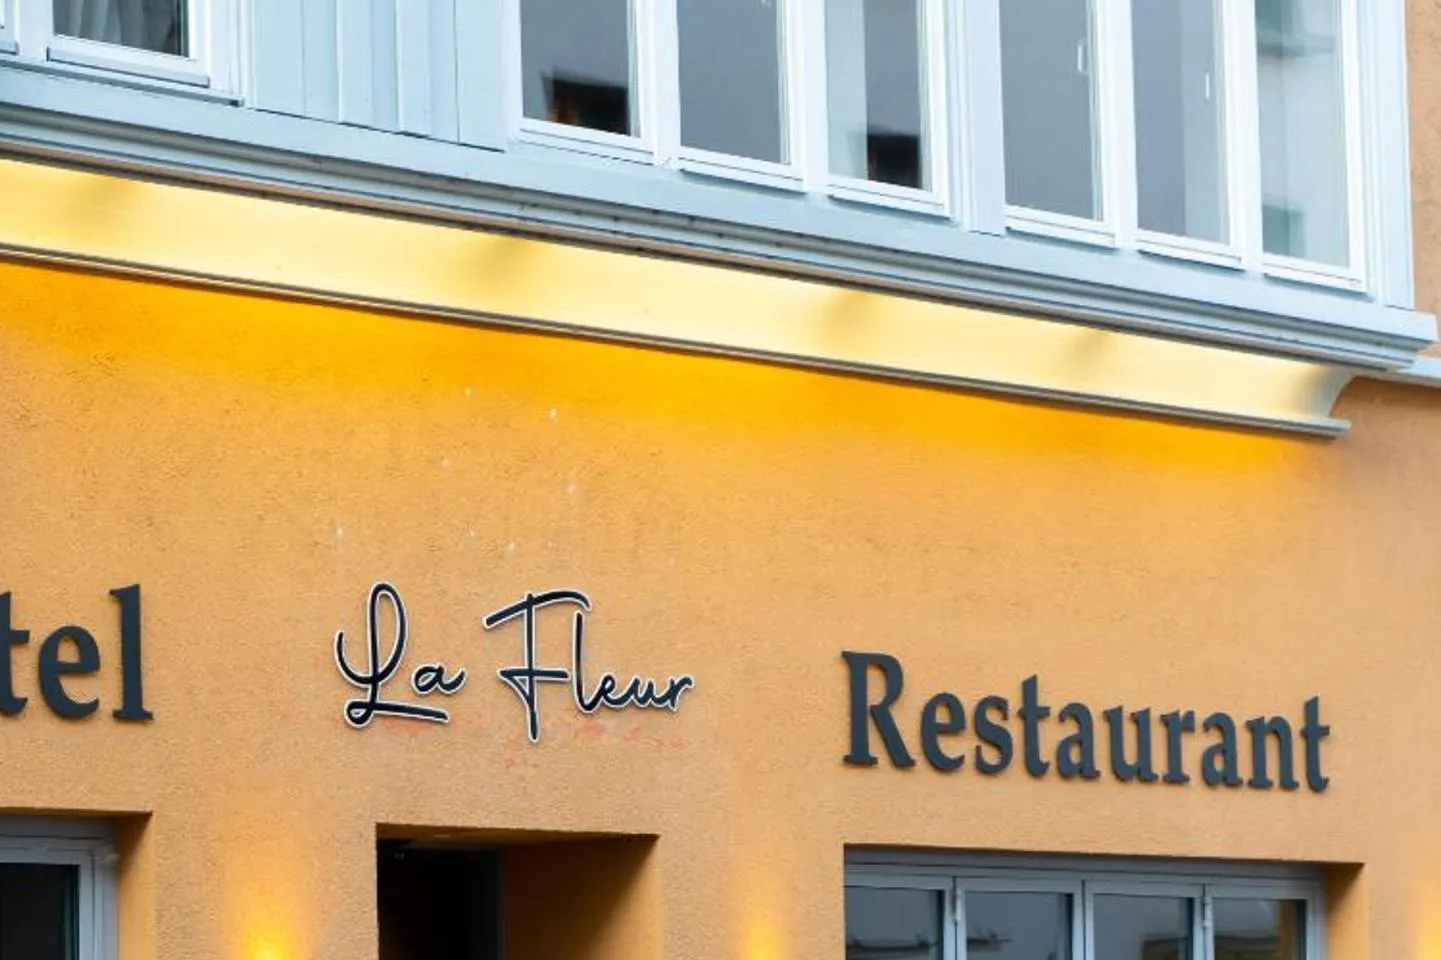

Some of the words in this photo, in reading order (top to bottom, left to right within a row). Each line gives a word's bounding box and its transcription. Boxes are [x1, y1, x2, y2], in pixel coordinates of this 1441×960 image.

[334, 581, 467, 728] La
[483, 588, 695, 742] Fleur
[841, 650, 1330, 792] Restaurant
